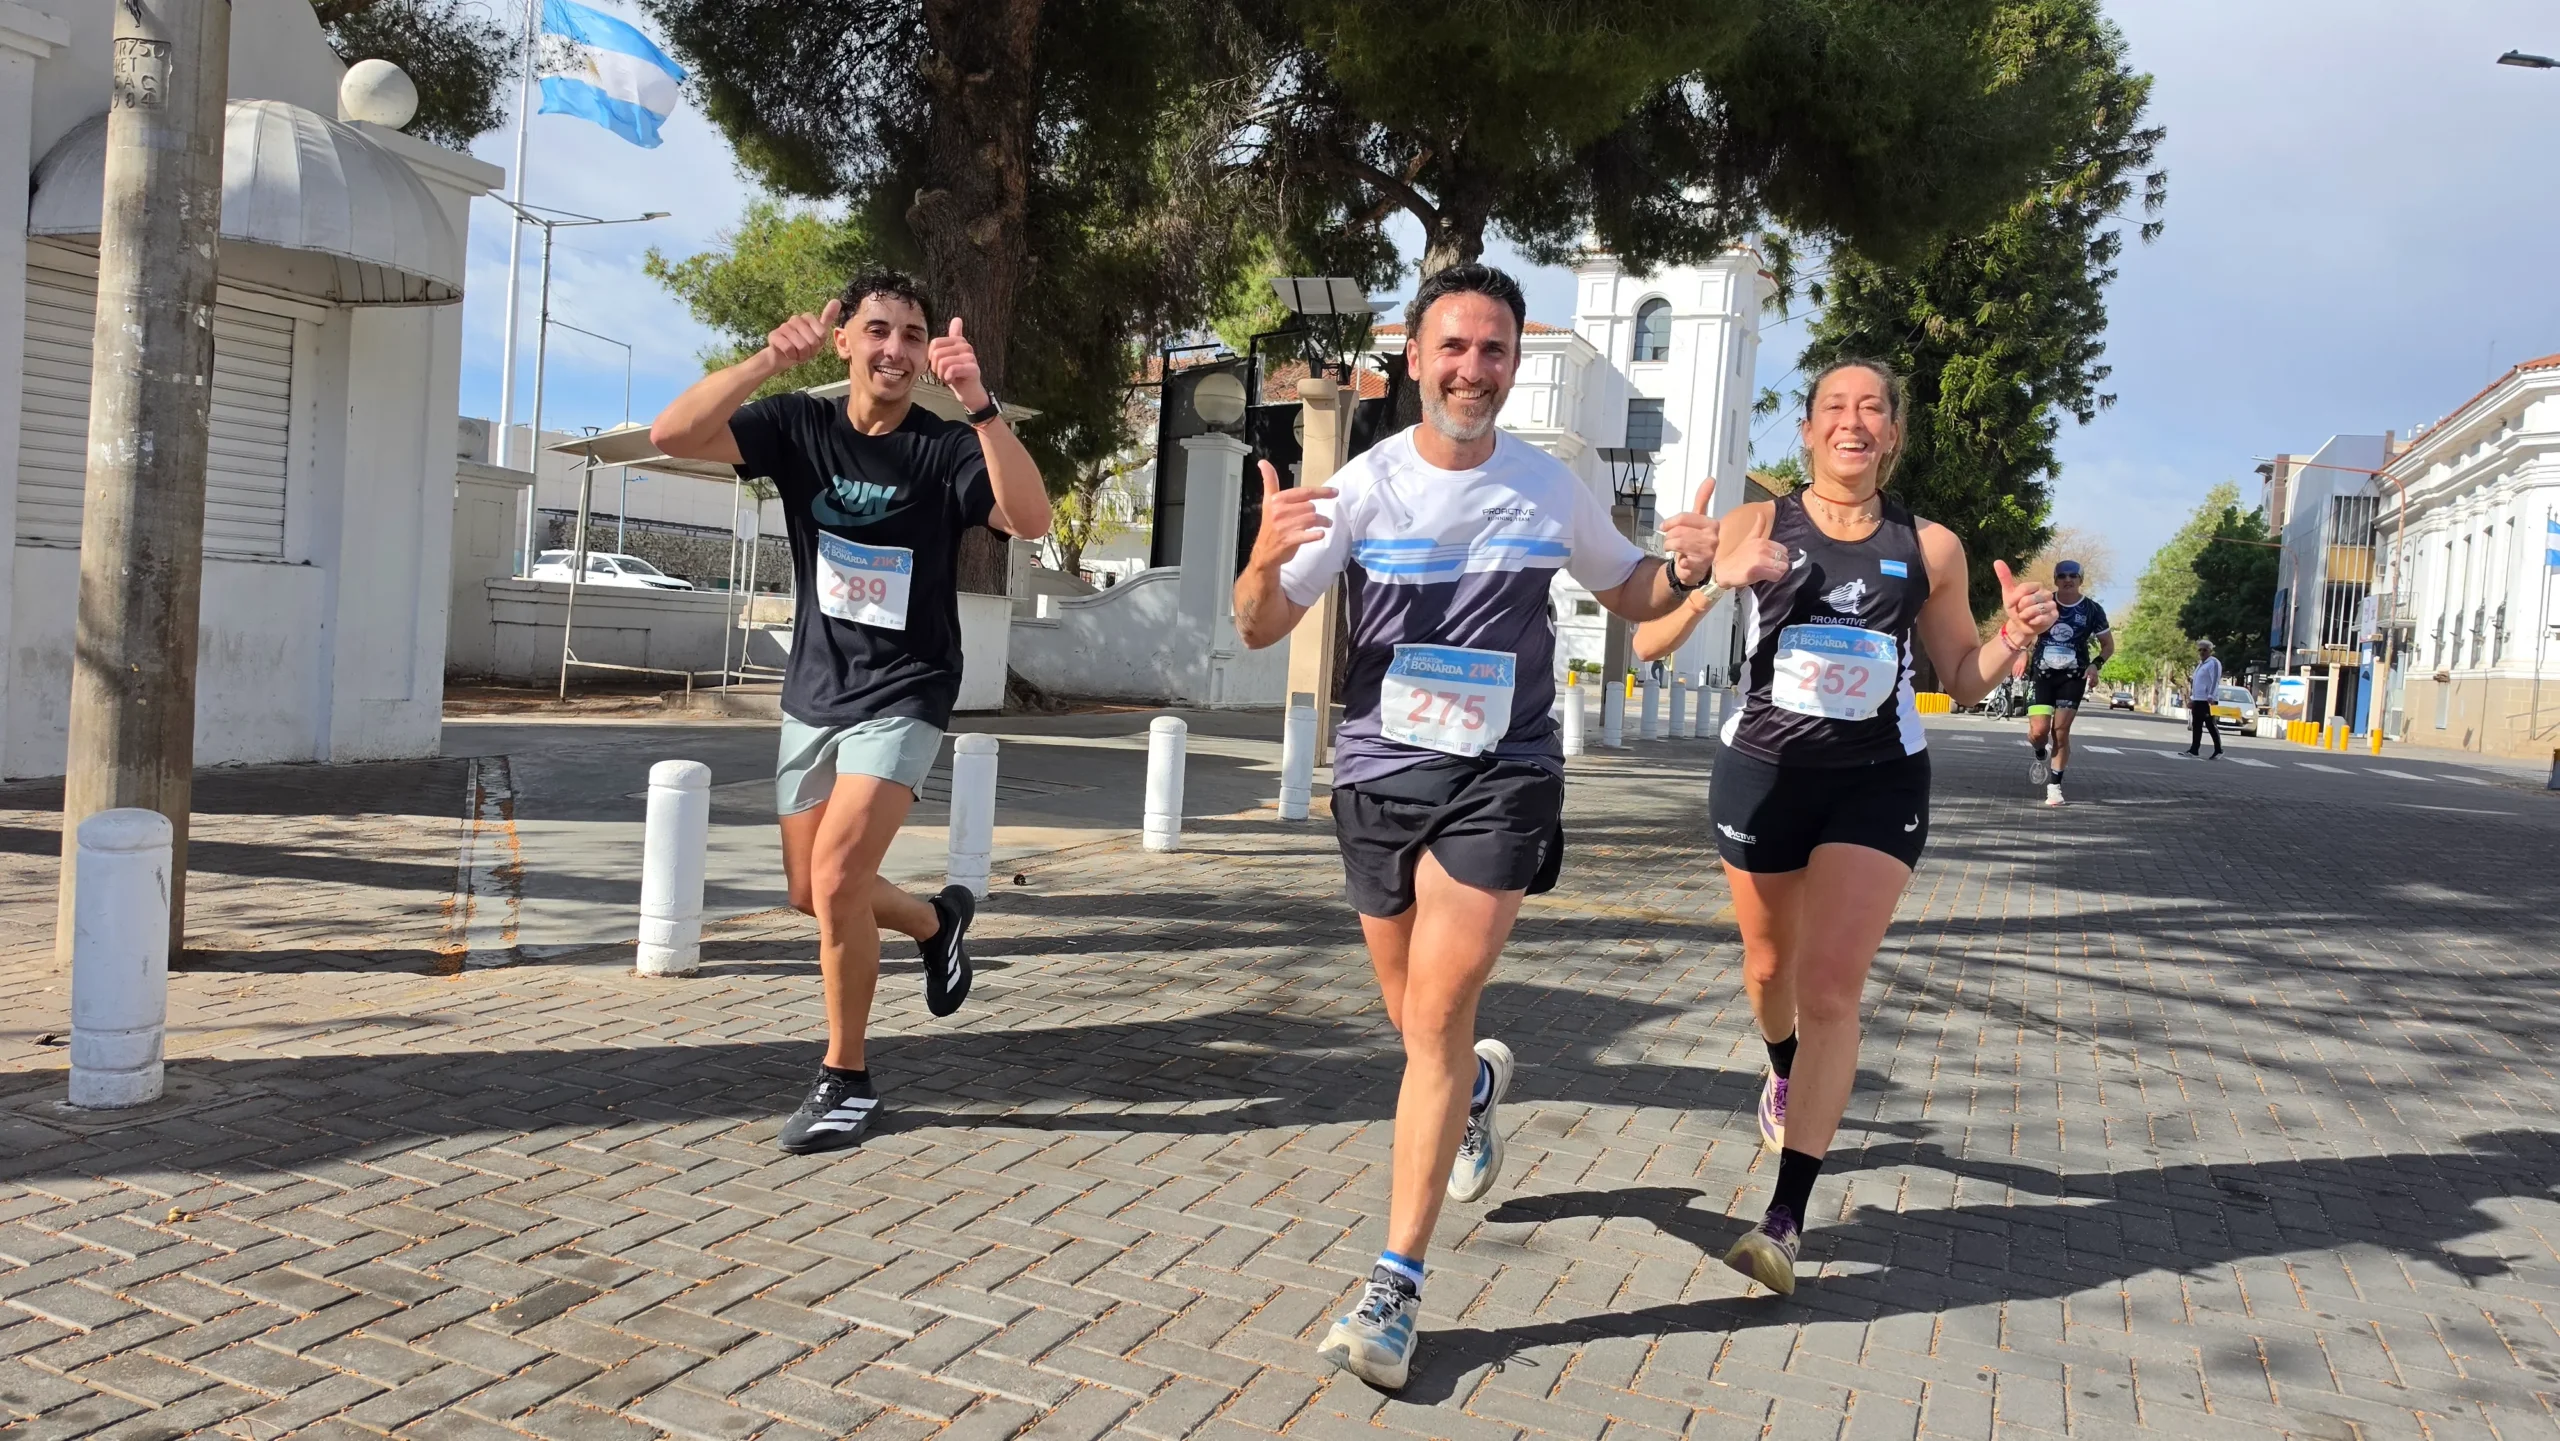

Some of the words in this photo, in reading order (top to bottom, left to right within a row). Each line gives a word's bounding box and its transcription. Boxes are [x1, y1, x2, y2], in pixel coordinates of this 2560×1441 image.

[830, 474, 897, 515] RUN
[1482, 507, 1535, 516] PROACTIVE
[831, 549, 868, 565] BONARDA
[872, 556, 895, 568] 21K
[829, 571, 887, 605] 289
[1810, 615, 1867, 627] PROACTIVE
[1800, 637, 1849, 649] BONARDA
[1411, 660, 1464, 675] BONARDA
[1469, 663, 1497, 678] 21K
[1798, 660, 1870, 698] 252
[1407, 688, 1486, 730] 275
